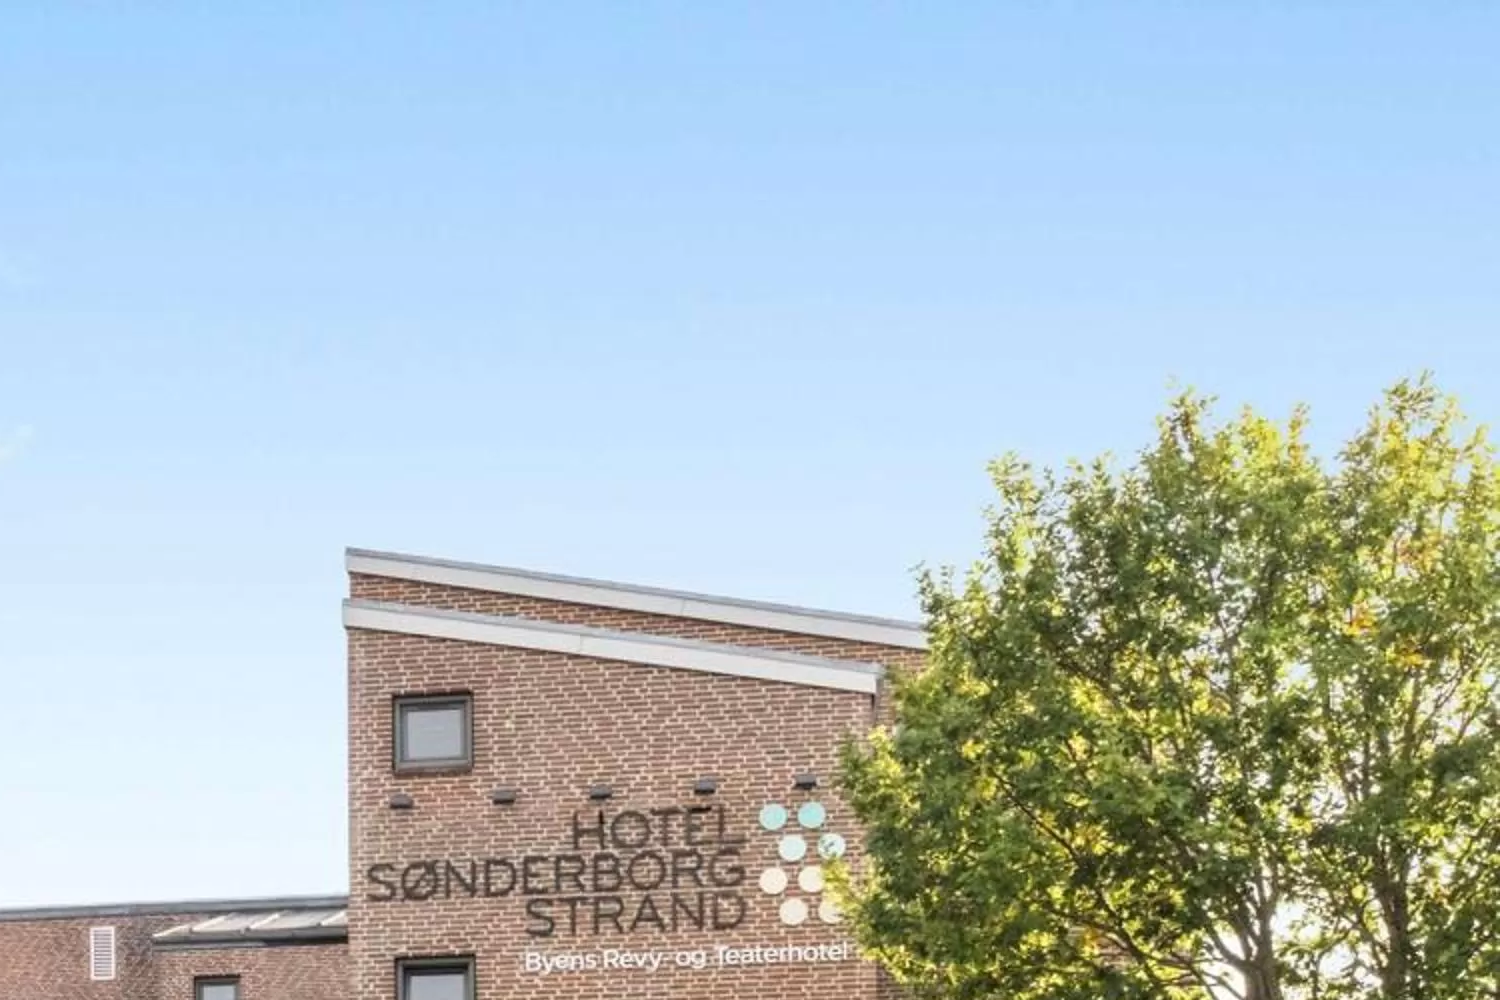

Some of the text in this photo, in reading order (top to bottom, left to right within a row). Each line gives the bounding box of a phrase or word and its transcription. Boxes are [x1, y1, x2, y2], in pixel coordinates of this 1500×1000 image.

[572, 804, 744, 850] HOTEL
[366, 848, 745, 900] SØNDERBORG
[525, 890, 746, 938] STRAND
[525, 941, 848, 975] Byens Revy- og Teaterhotel
